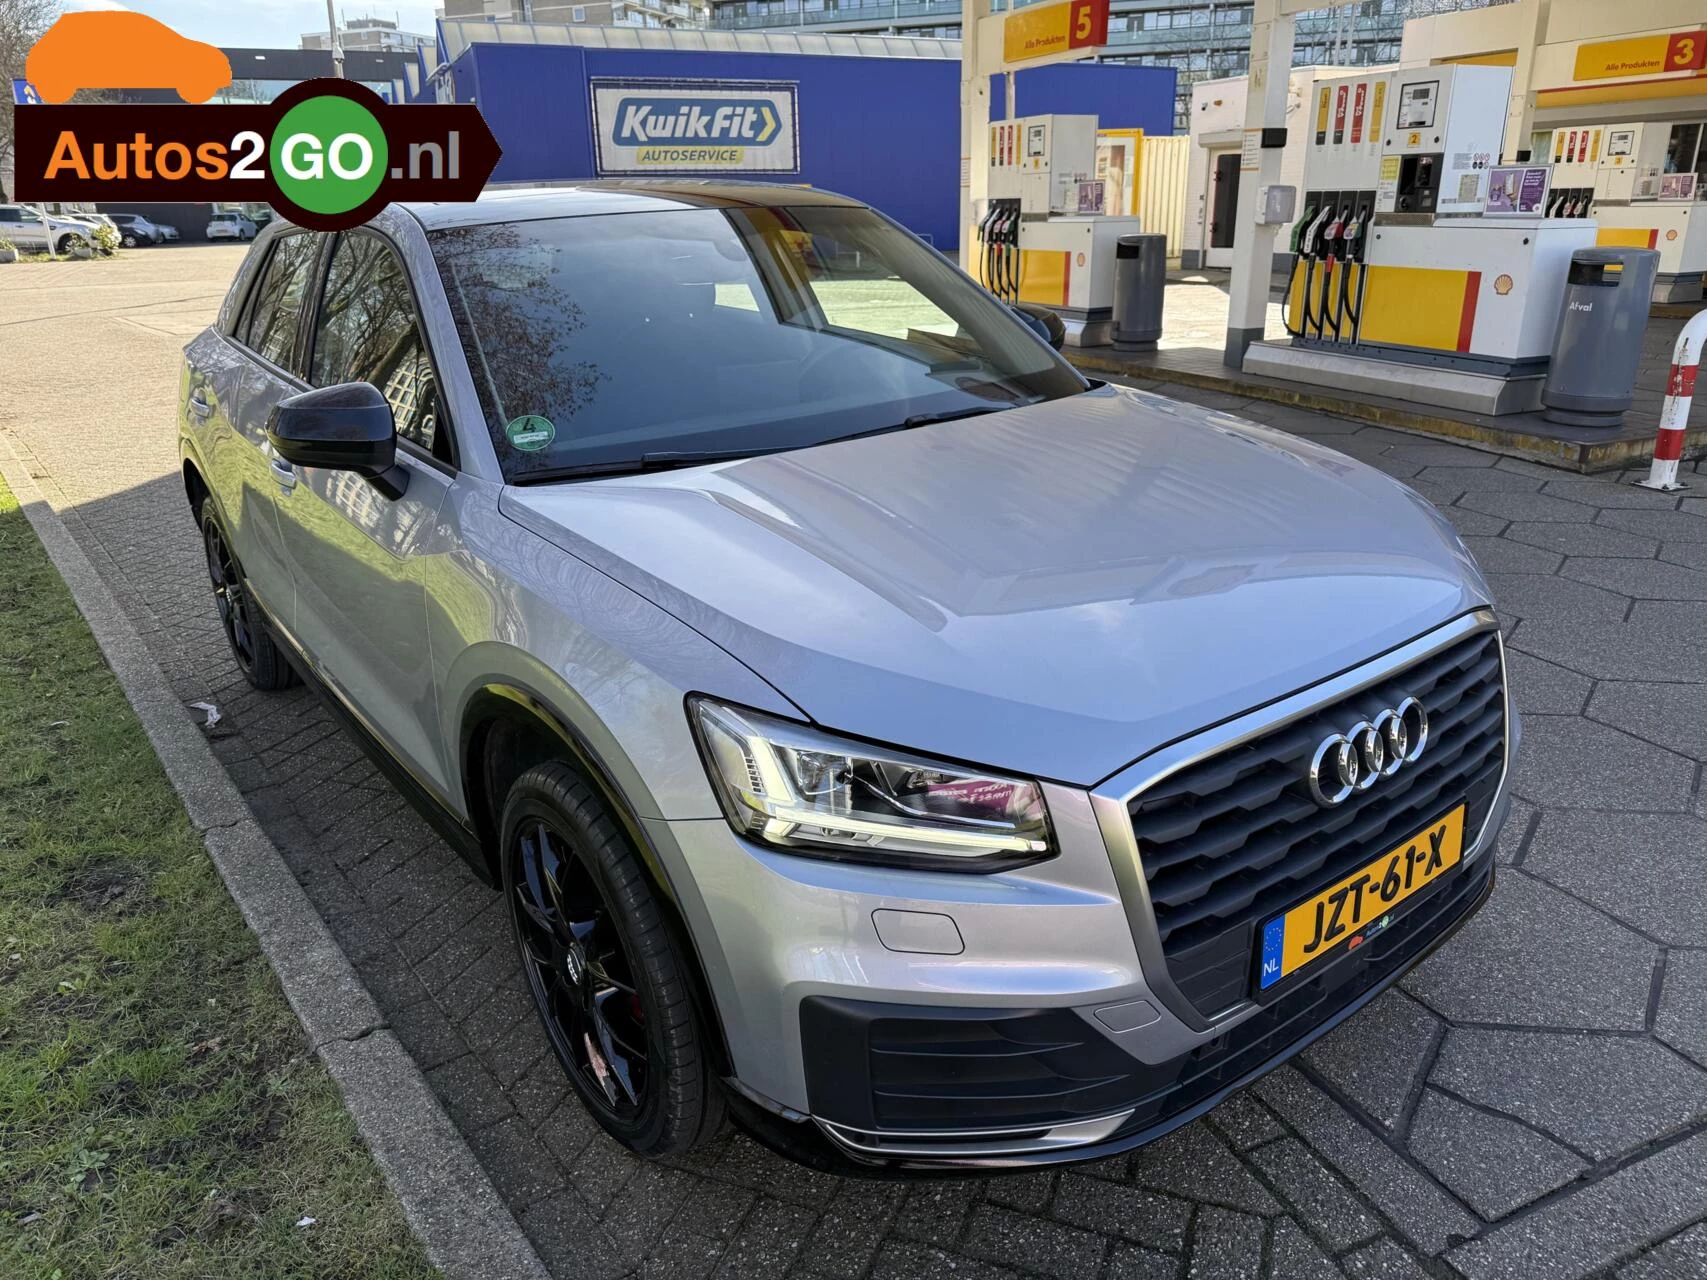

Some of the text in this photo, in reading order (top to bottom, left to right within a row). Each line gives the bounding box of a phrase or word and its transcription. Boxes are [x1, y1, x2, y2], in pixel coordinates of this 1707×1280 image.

[1075, 5, 1092, 40] 5
[1673, 38, 1695, 65] 3
[1605, 59, 1660, 72] Alle Produkten
[1411, 134, 1419, 144] 2
[642, 149, 738, 162] AUTOSERVICE
[1569, 301, 1593, 313] Afval
[1303, 824, 1447, 954] JZT-61-X
[1264, 957, 1279, 977] NL
